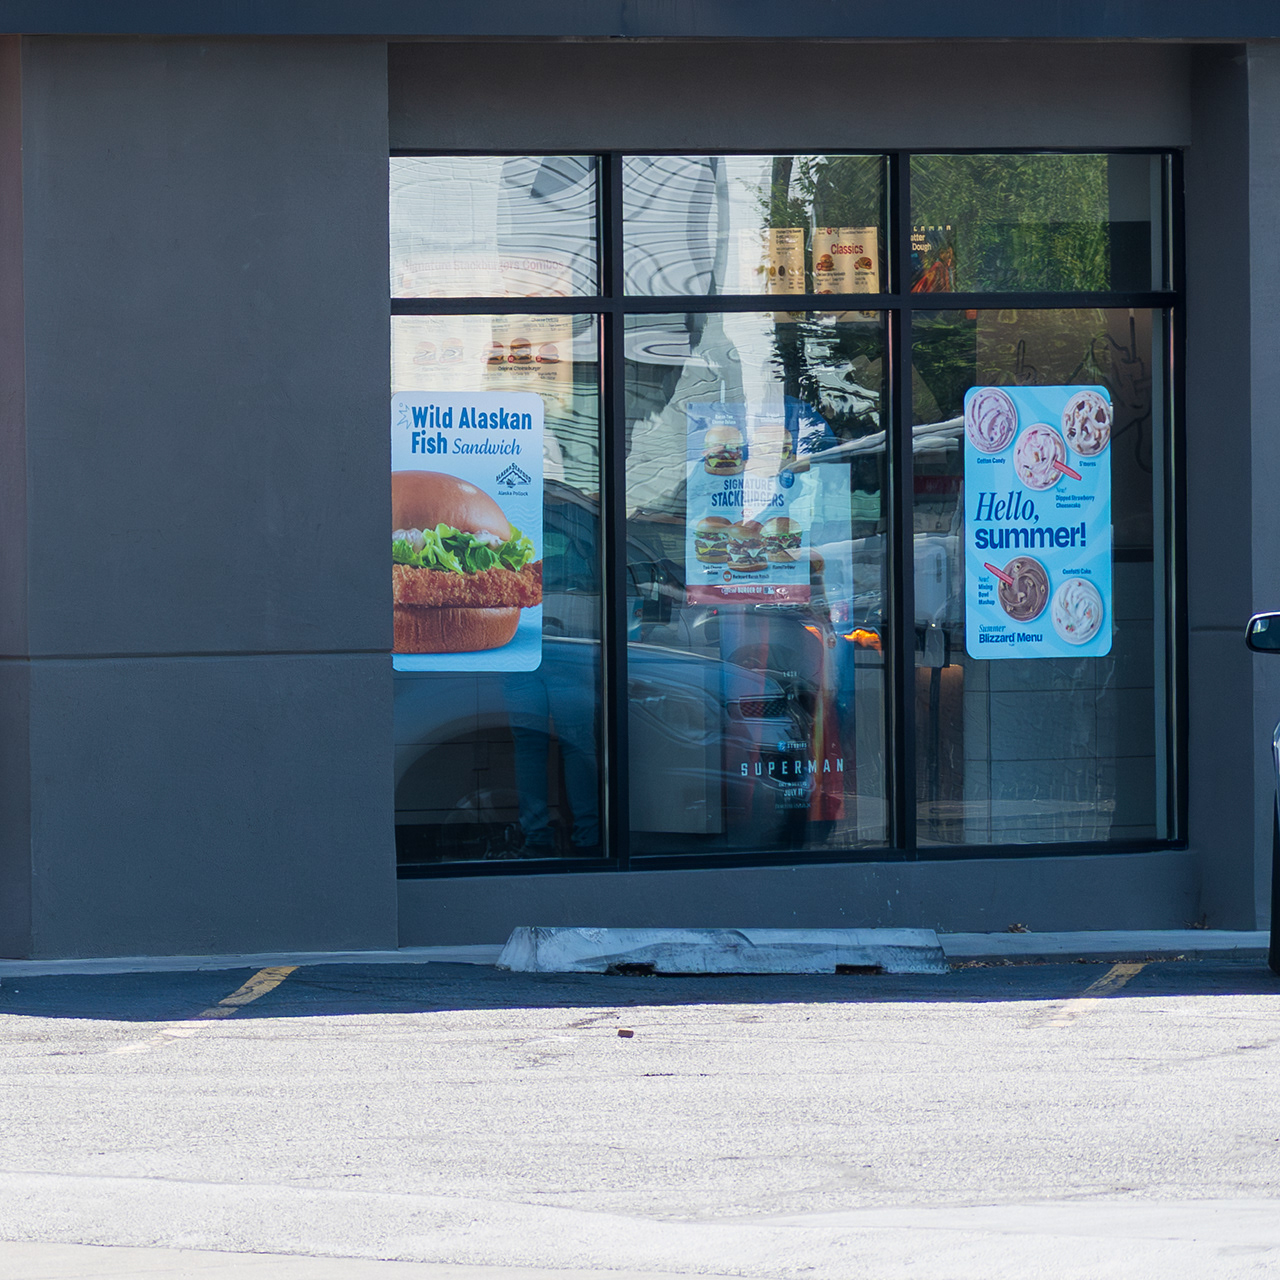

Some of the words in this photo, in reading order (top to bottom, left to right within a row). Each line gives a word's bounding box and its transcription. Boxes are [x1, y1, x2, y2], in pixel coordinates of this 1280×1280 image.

[830, 243, 864, 255] Classics
[411, 404, 453, 429] Wild
[458, 407, 532, 430] Alaskan
[411, 429, 448, 454] Fish
[452, 438, 522, 455] Sandwich
[992, 457, 1006, 465] Candy
[723, 479, 774, 491] SIGNATURE
[711, 491, 785, 507] STACKBURGERS
[973, 490, 1039, 525] Hello,
[974, 521, 1087, 549] summer!
[979, 624, 1006, 633] Summer
[979, 633, 1014, 643] Blizzard
[1017, 632, 1043, 643] Menu
[741, 758, 844, 776] SUPERMAN
